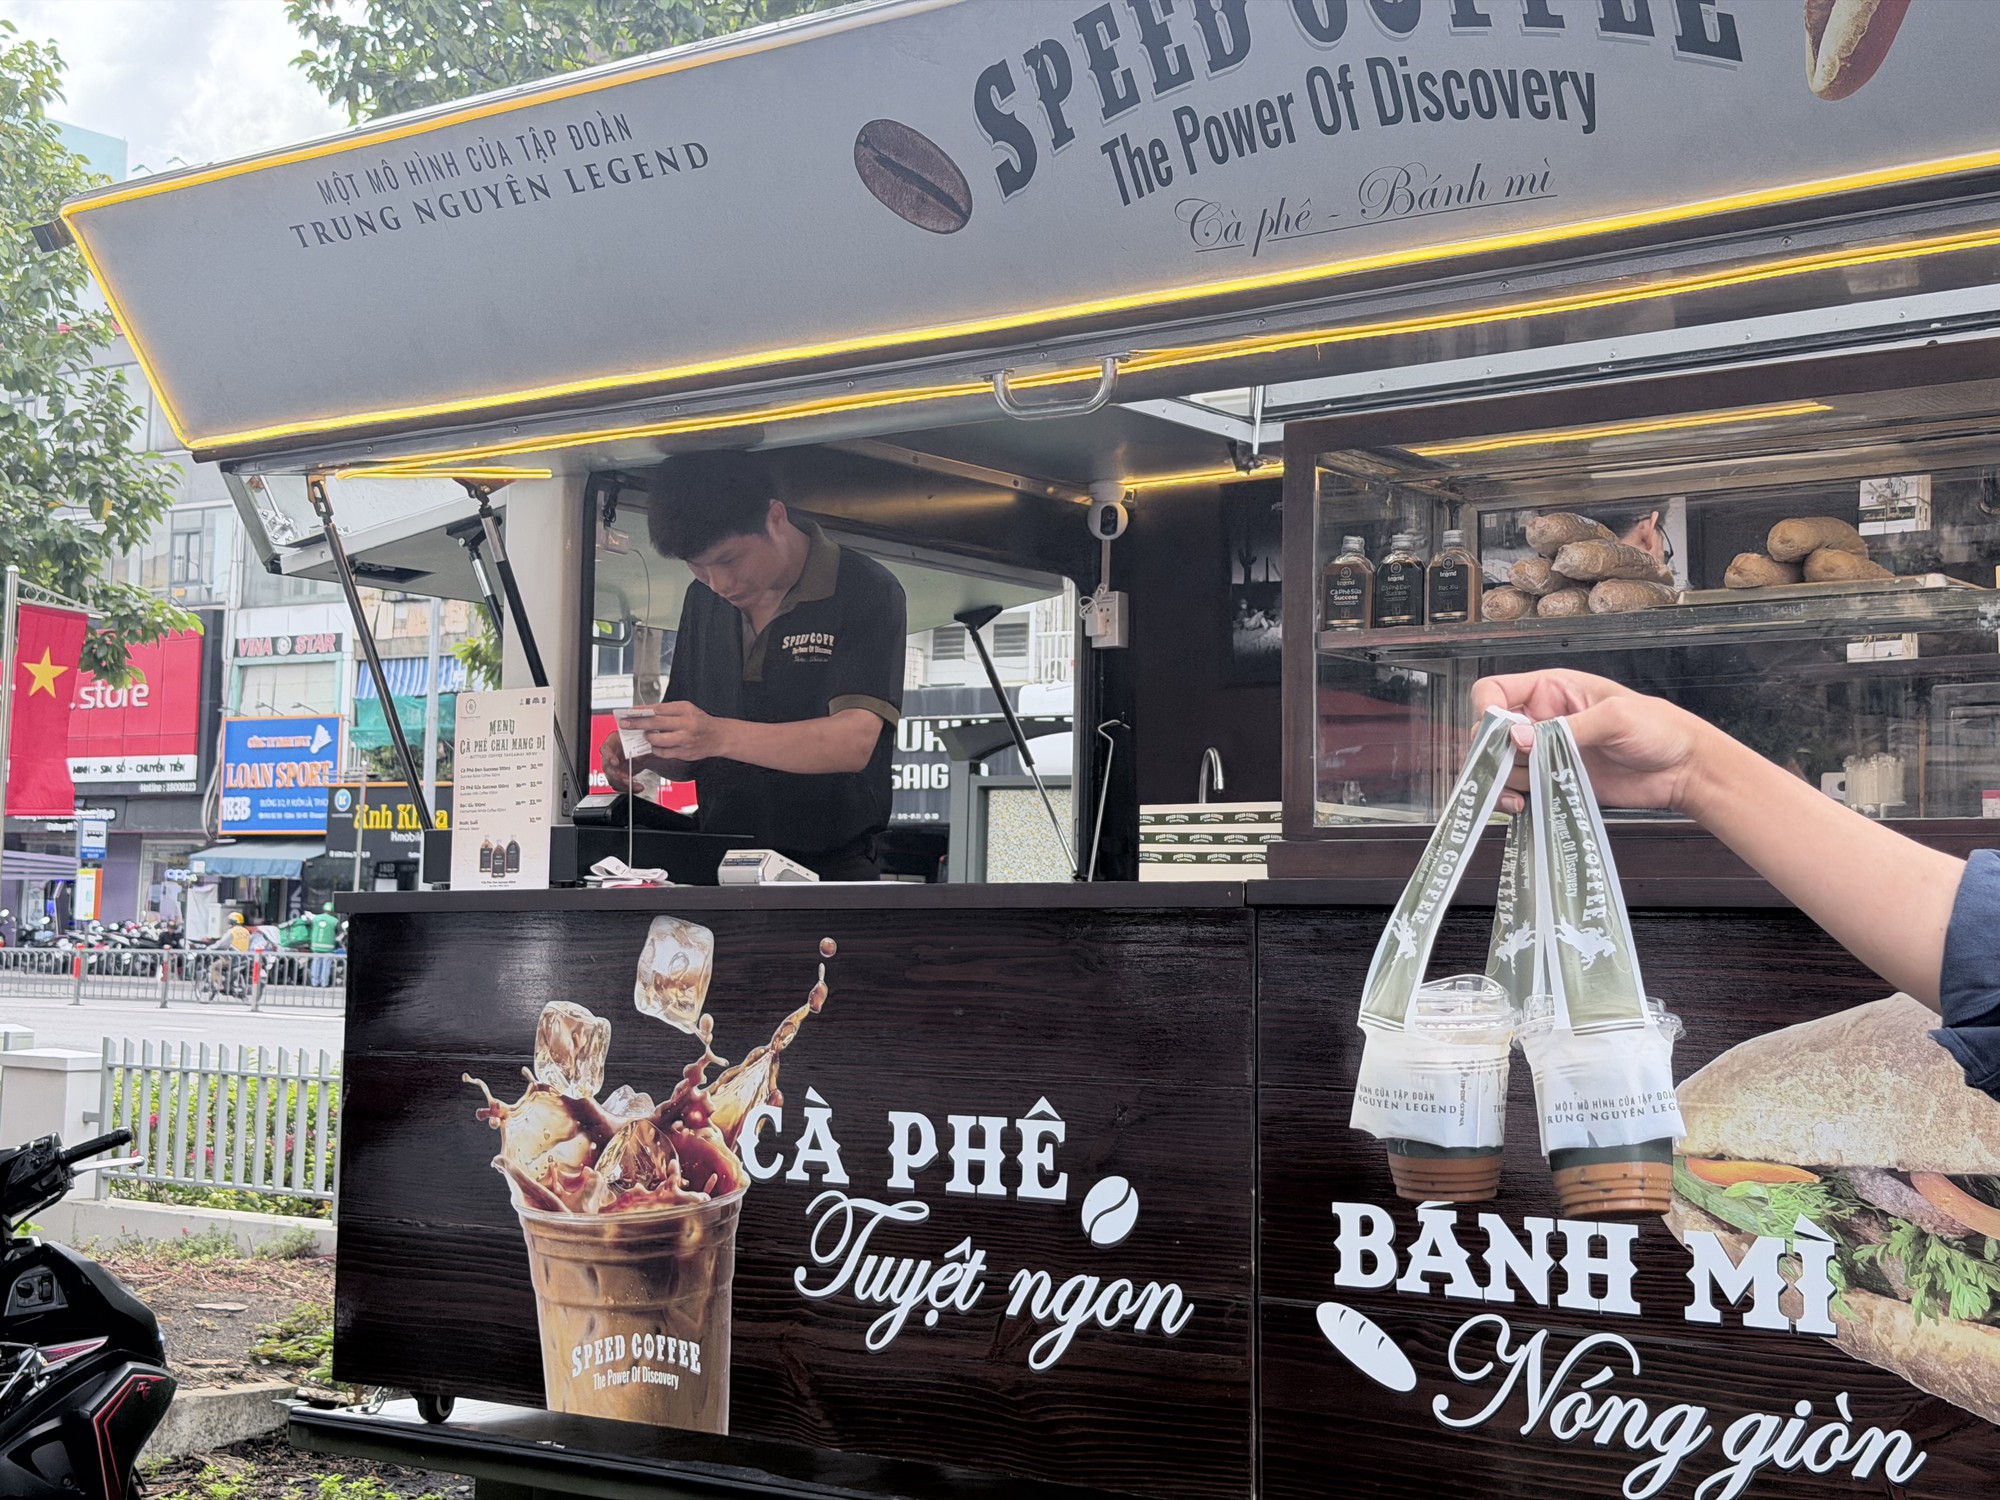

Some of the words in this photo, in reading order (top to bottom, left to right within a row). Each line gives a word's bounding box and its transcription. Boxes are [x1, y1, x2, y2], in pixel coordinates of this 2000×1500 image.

[1100, 132, 1174, 207] The
[1172, 92, 1297, 176] Power
[1305, 63, 1360, 136] Of
[1366, 56, 1597, 135] Discovery
[316, 169, 362, 207] MỘT
[366, 159, 401, 195] MÔ
[403, 149, 462, 186] HÌNH
[465, 135, 513, 174] CỦA
[515, 126, 559, 165] TẬP
[569, 110, 634, 152] ĐOÀN
[289, 206, 402, 249] TRUNG
[412, 173, 553, 226] NGUYÊN
[563, 140, 710, 195] LEGEND
[1174, 197, 1247, 248] Cà
[1251, 197, 1313, 258] phê
[1358, 161, 1494, 220] Bánh
[1503, 157, 1560, 198] mì
[238, 637, 273, 657] VINA
[295, 633, 336, 654] STAR
[460, 738, 471, 755] CÀ
[491, 739, 508, 752] CHAI
[511, 737, 533, 751] MANG
[489, 719, 515, 737] MENU
[225, 763, 275, 789] LOAN
[276, 761, 334, 788] SPORT
[222, 796, 251, 822] 183B
[1450, 780, 1479, 844] SPEED
[1555, 811, 1569, 841] Power
[1562, 840, 1577, 853] Of
[1411, 849, 1459, 925] COFFEE
[1563, 852, 1579, 898] Discovery
[1582, 838, 1608, 922] COFFEE
[1406, 1102, 1457, 1114] LEGEND
[1555, 1101, 1573, 1112] MỘT
[1592, 1097, 1614, 1109] HÌNH
[1590, 1108, 1645, 1121] NGUYÊN
[738, 1086, 850, 1186] CÀ
[887, 1096, 1068, 1201] PHÊ
[794, 1190, 987, 1354] Tuyệt
[1007, 1268, 1195, 1373] ngon
[1332, 1200, 1642, 1316] BÁNH
[1684, 1213, 1838, 1338] MÌ
[571, 1334, 626, 1378] SPEED
[631, 1332, 701, 1376] COFFEE
[593, 1373, 606, 1391] The
[607, 1369, 630, 1388] Power
[631, 1366, 641, 1384] Of
[642, 1366, 679, 1391] Discovery
[1432, 1313, 1714, 1500] Nóng
[1694, 1390, 1928, 1500] giòn
